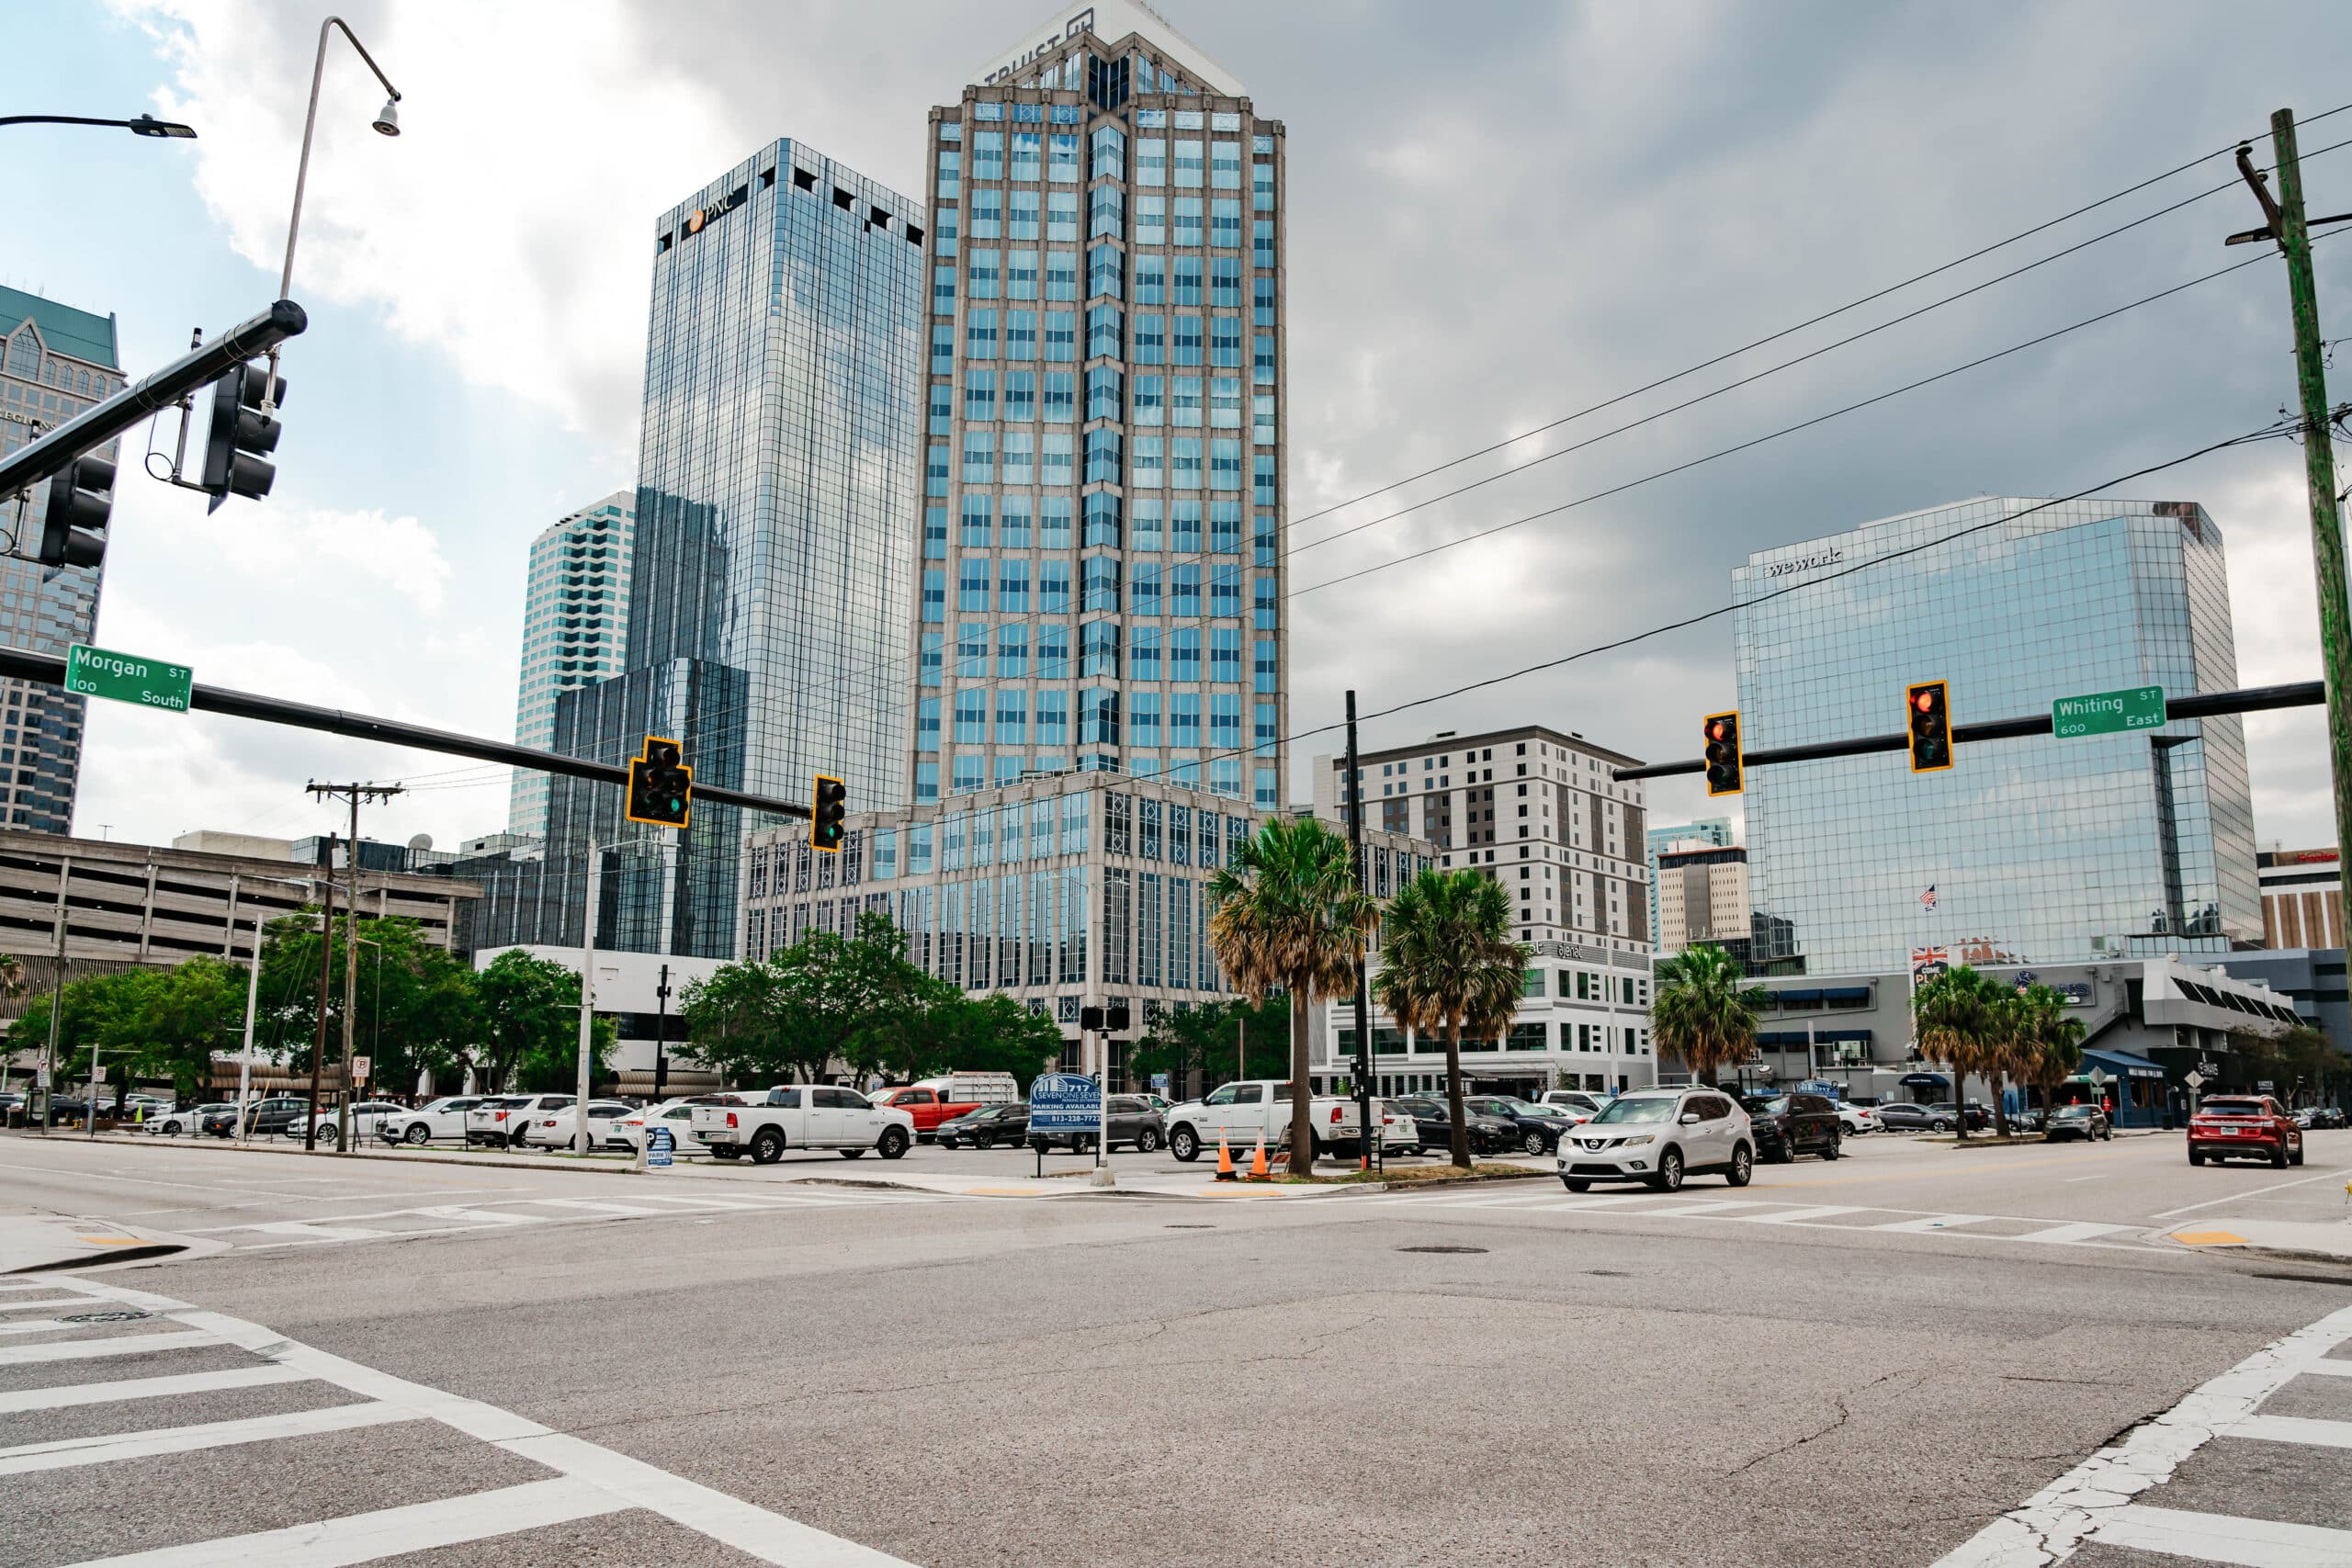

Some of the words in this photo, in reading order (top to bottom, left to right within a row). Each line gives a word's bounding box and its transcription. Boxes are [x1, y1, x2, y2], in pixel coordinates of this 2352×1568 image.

[705, 192, 734, 222] PNC
[1770, 547, 1842, 578] wework
[74, 648, 148, 678] Morgan
[169, 667, 187, 679] ST
[73, 678, 96, 692] 100
[141, 690, 183, 708] South
[2059, 697, 2123, 716] Whiting
[2140, 690, 2156, 700] ST
[2061, 723, 2086, 735] 600
[2126, 713, 2159, 727] East
